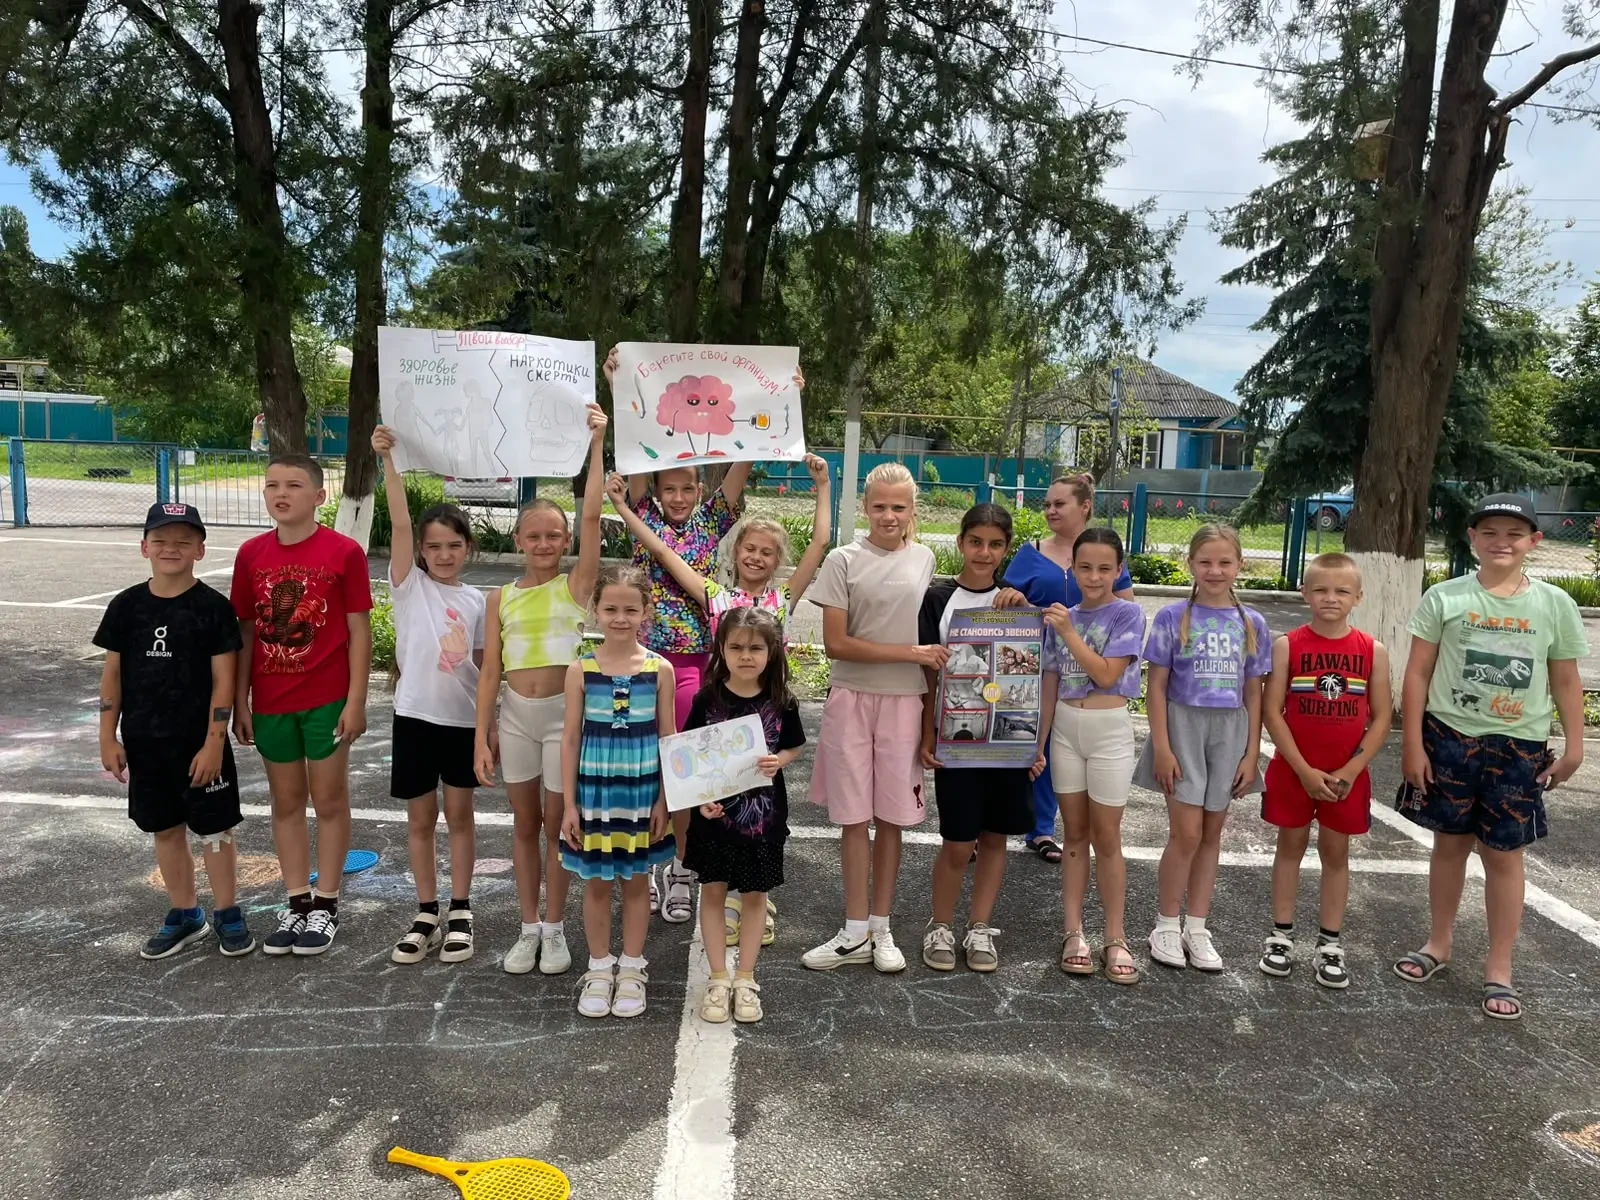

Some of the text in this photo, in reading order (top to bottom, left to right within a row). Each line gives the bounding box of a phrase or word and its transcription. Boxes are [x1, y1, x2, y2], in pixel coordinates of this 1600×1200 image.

[637, 350, 694, 378] Берегите
[700, 350, 728, 362] свой
[949, 627, 1041, 637] НЕ СТАНОВИСЬ ЗВЕНОМ!
[146, 650, 173, 658] DESIGN
[1207, 632, 1231, 658] 93
[1300, 652, 1365, 677] HAWAII
[1298, 696, 1359, 717] SURFING
[205, 781, 230, 793] DESIGN
